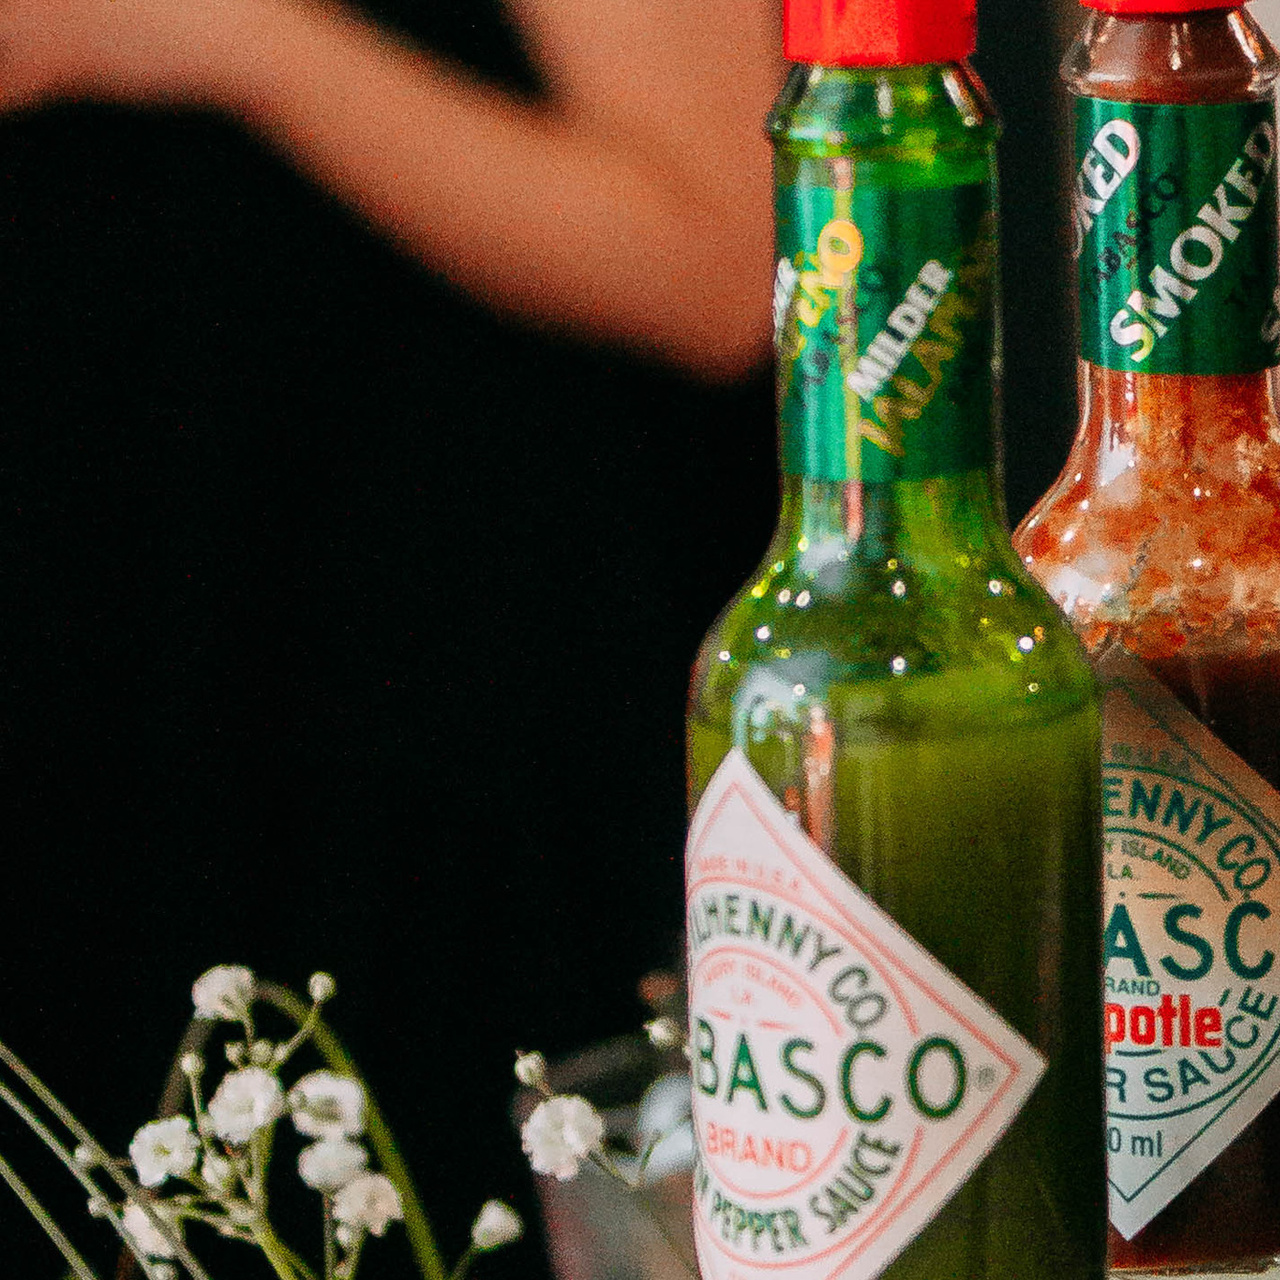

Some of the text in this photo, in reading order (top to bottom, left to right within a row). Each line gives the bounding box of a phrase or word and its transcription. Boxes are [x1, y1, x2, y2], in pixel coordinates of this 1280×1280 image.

[1110, 122, 1277, 364] SMOKED
[1143, 986, 1280, 1103] SAUCE
[705, 1121, 814, 1174] BRAND
[711, 1188, 809, 1254] PEPPER
[807, 1130, 904, 1235] SAUCE
[1131, 1130, 1163, 1158] ml
